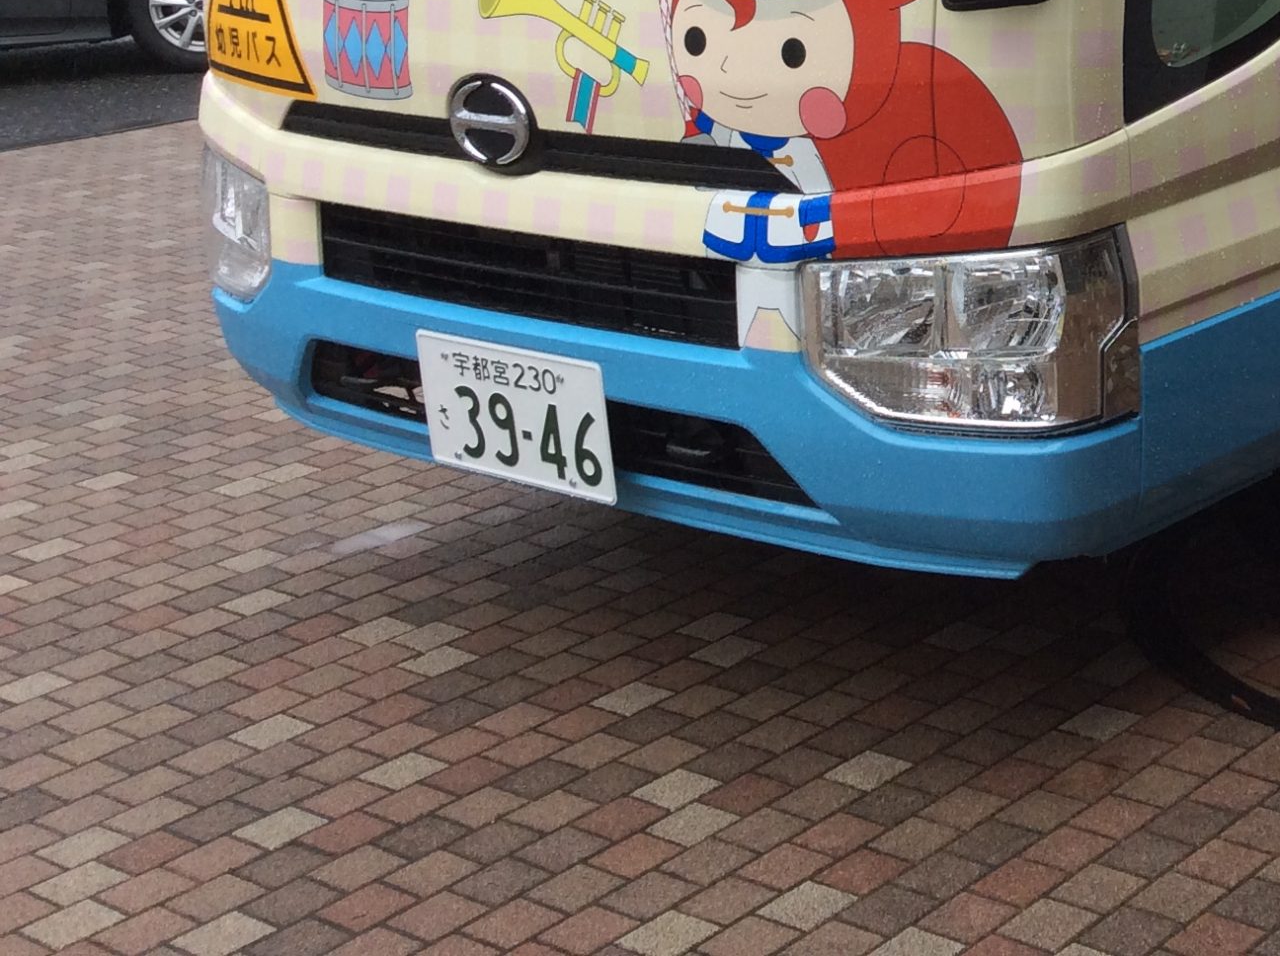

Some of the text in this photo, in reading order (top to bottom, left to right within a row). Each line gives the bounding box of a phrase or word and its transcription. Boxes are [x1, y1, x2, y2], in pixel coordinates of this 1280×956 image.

[215, 23, 282, 68] 幼児バス
[438, 385, 603, 487] さ 39-46
